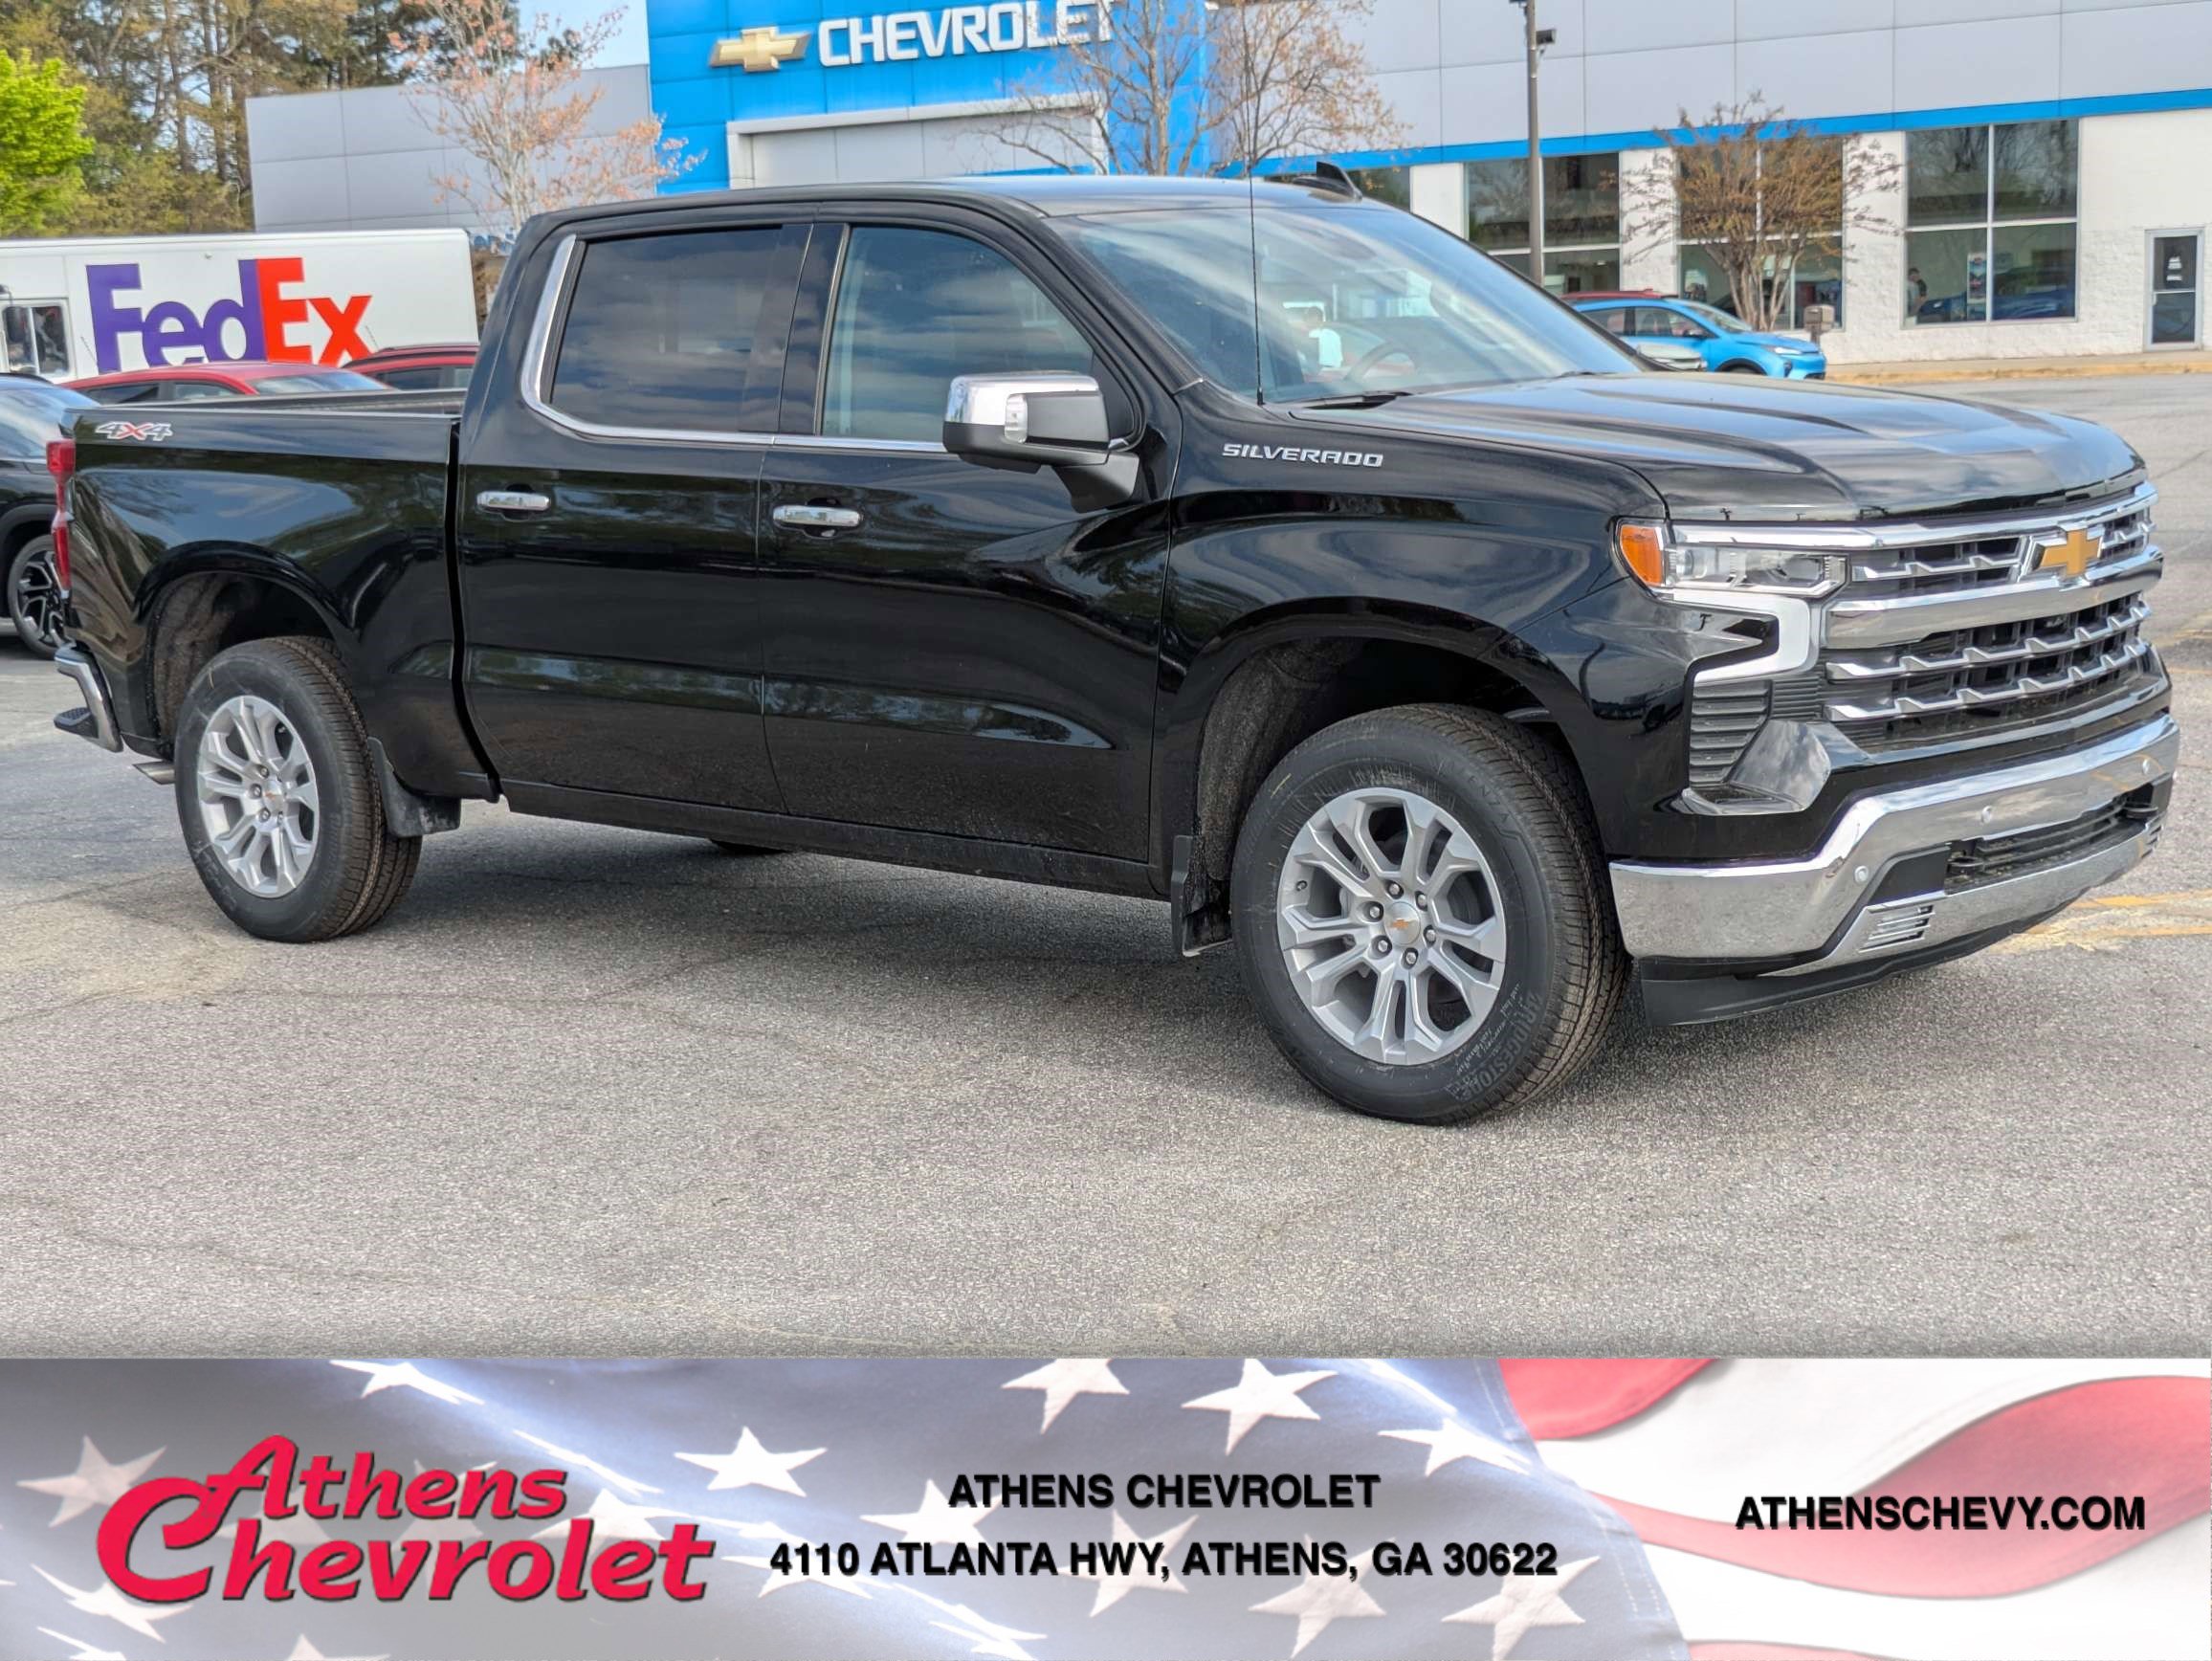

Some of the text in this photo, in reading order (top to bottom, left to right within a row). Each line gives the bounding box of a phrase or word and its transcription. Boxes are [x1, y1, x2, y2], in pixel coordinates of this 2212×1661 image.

[818, 0, 1115, 67] CHEVROLET
[85, 256, 373, 376] FedEx
[1222, 443, 1384, 468] SILVERADO
